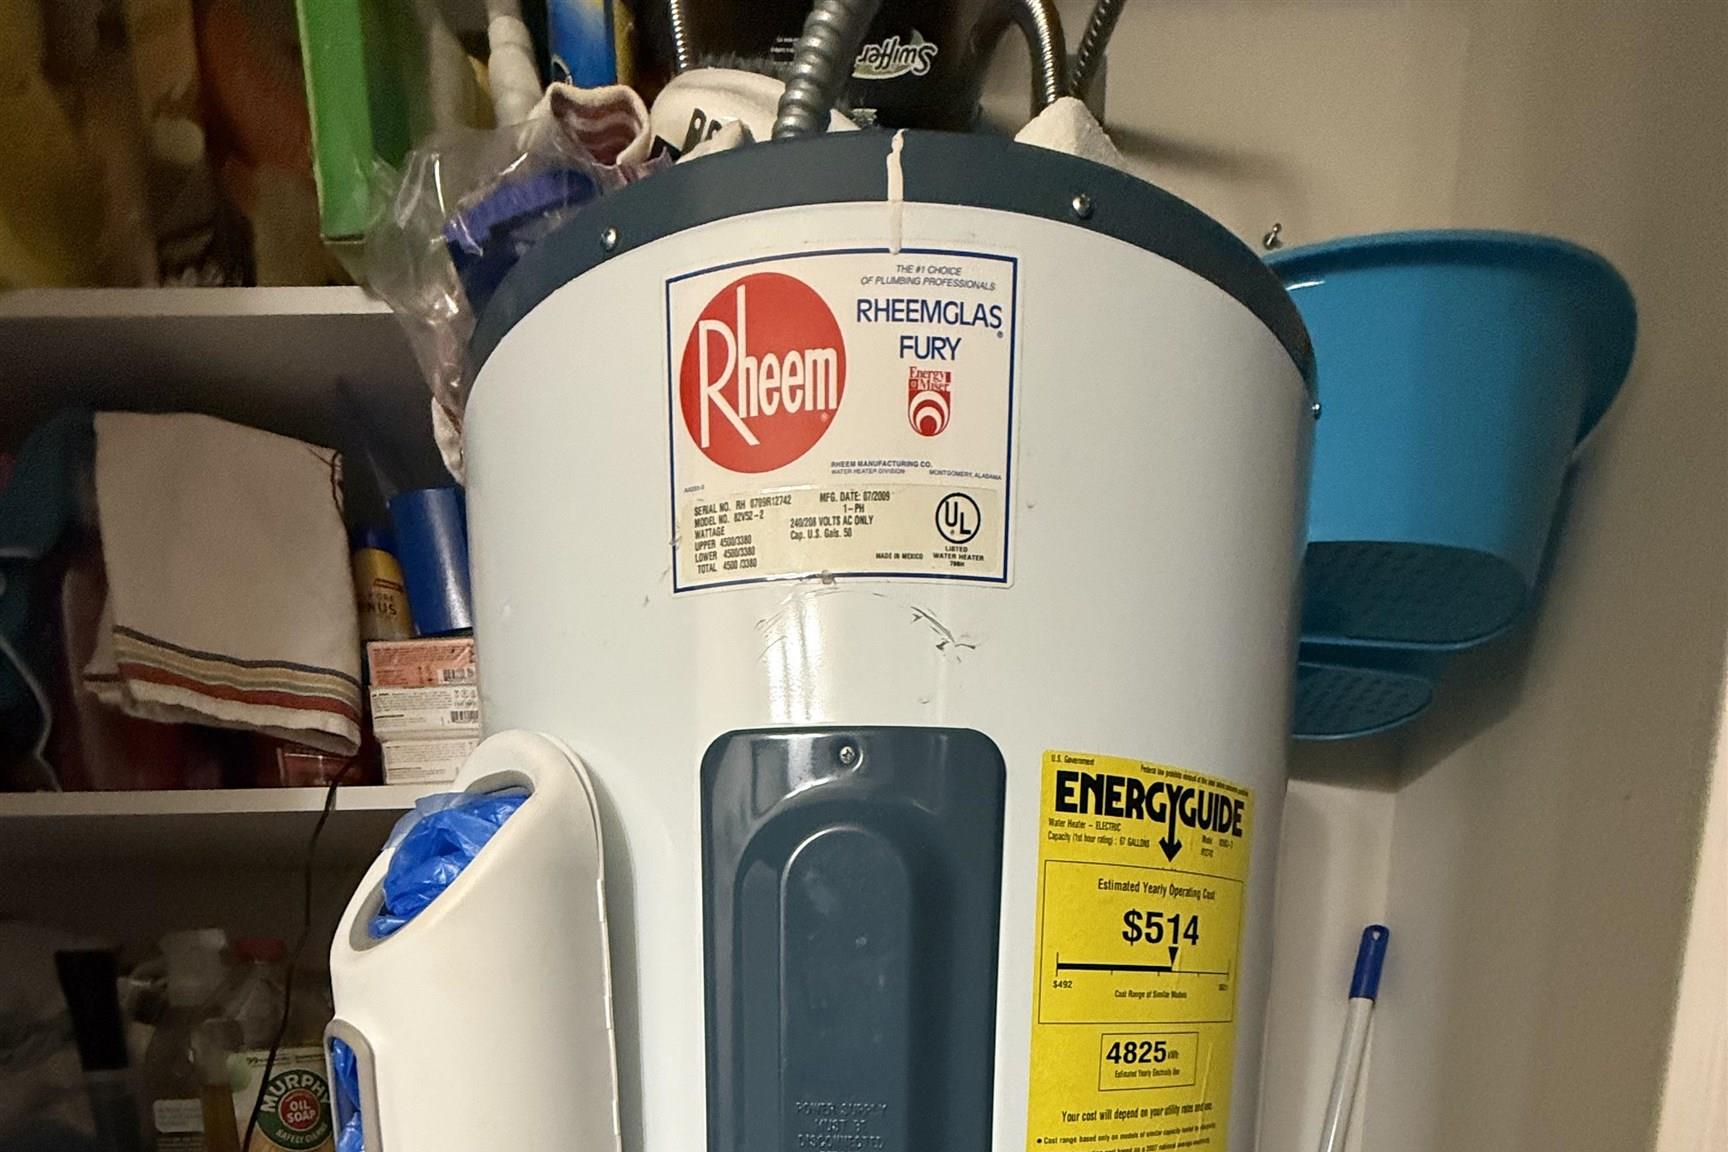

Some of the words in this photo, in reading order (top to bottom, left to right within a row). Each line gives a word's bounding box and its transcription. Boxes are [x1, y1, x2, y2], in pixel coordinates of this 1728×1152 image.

[858, 36, 938, 76] Swiffer
[896, 265, 913, 274] THE
[915, 266, 924, 274] #1
[927, 266, 962, 276] CHOICE
[861, 276, 874, 285] OF
[875, 276, 921, 285] PLUMBING
[923, 277, 996, 291] PROFESSIONALS
[857, 298, 1002, 329] RHEEMGLAS
[900, 335, 962, 361] FURY
[698, 284, 837, 449] Rheem
[909, 366, 945, 382] Energy
[920, 379, 950, 391] Miser
[831, 460, 856, 468] RHEEM
[857, 460, 919, 468] MANUFACTURING
[820, 492, 838, 502] MFG.
[840, 491, 861, 502] DATE:
[863, 490, 890, 502] 07/2009
[694, 504, 717, 517] SERIAL
[720, 502, 731, 513] NO.
[735, 500, 746, 510] RH
[694, 515, 717, 528] MODEL
[718, 513, 730, 524] NO.
[819, 516, 841, 527] VOLTS
[842, 515, 852, 526] AC
[854, 515, 874, 525] ONLY
[694, 526, 725, 539] WATTAGE
[790, 530, 806, 541] Cap.
[807, 528, 822, 539] U.S.
[824, 527, 842, 538] Gals.
[843, 527, 852, 537] 50
[695, 539, 716, 551] UPPER
[695, 550, 718, 563] LOWER
[875, 552, 892, 560] MADE
[901, 552, 923, 560] MEXICO
[958, 553, 984, 561] HEATER
[697, 563, 718, 574] TOTAL
[1064, 755, 1095, 766] Government
[1055, 770, 1244, 838] ENERGYGUIDE
[1048, 818, 1065, 828] Water
[1067, 818, 1086, 829] Heater
[1096, 821, 1121, 832] ELECTRIC
[1048, 831, 1071, 843] Capacity
[1128, 837, 1150, 848] GALLONS
[1098, 878, 1140, 893] Estimated
[1143, 881, 1167, 898] Yearly
[1169, 884, 1201, 900] Operating
[1202, 887, 1216, 900] Cost
[1122, 908, 1199, 946] $514
[1053, 980, 1073, 989] $492
[1115, 990, 1126, 998] Cost
[1128, 990, 1145, 1000] Range
[1106, 1041, 1167, 1064] 4825
[1114, 1070, 1137, 1078] Estimated
[260, 1073, 330, 1113] MURPHY
[289, 1100, 311, 1111] OIL
[287, 1109, 316, 1123] SOAP
[1062, 1111, 1080, 1122] Your
[1082, 1110, 1097, 1121] cost
[1100, 1109, 1112, 1120] will
[1114, 1107, 1139, 1121] depend
[1140, 1109, 1148, 1118] on
[1150, 1107, 1163, 1118] your
[1044, 1136, 1058, 1144] Cost
[1059, 1136, 1077, 1145] range
[1079, 1134, 1096, 1142] based
[1098, 1133, 1110, 1142] only
